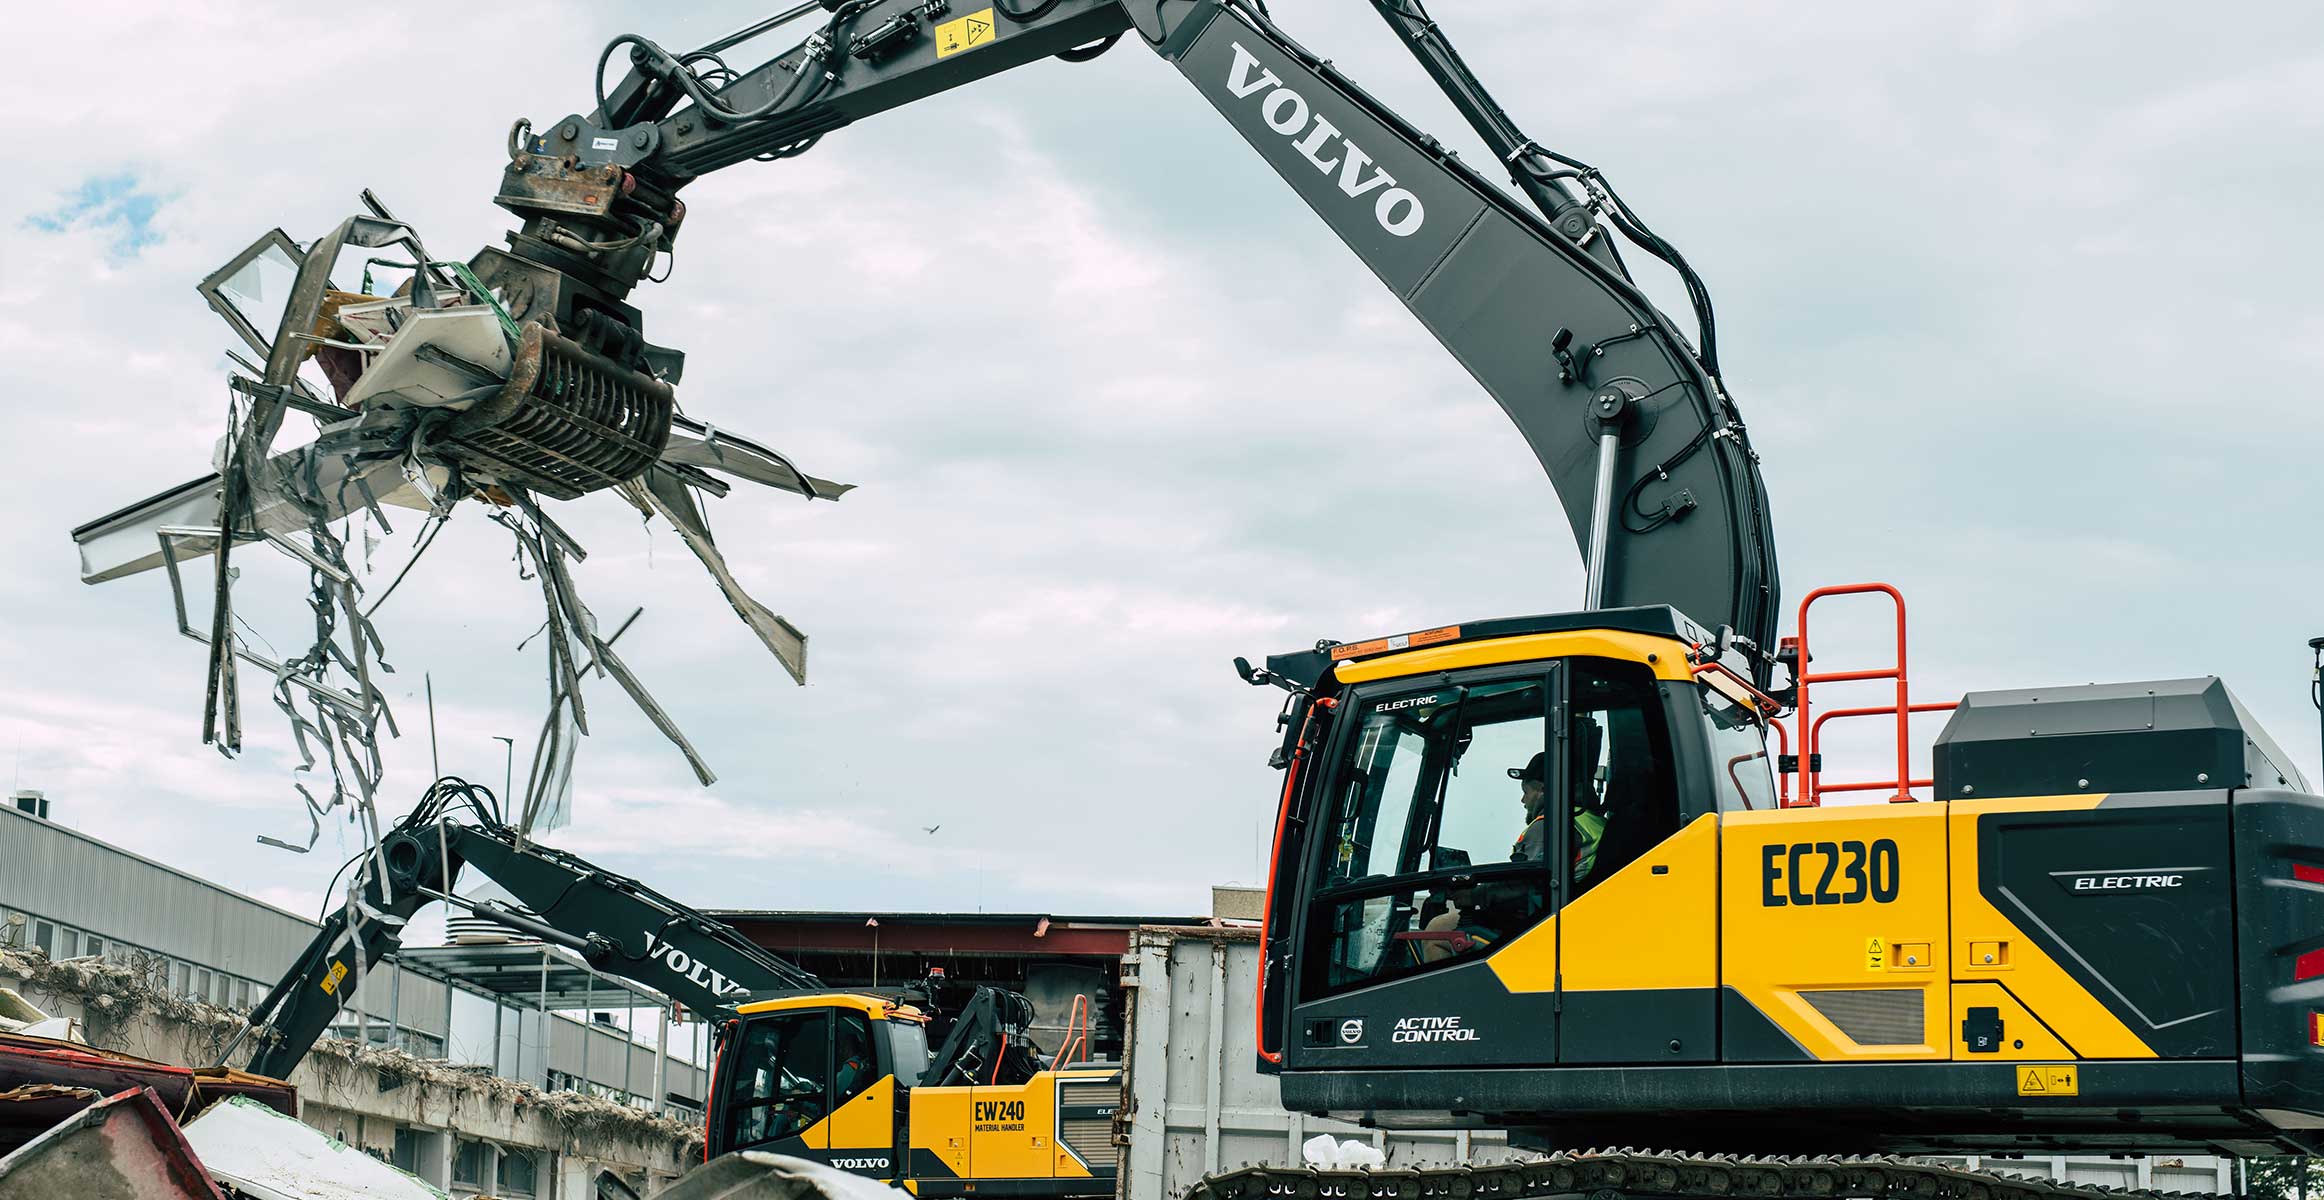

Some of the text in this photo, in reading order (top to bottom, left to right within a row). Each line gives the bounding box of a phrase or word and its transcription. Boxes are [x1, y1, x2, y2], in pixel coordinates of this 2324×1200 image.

[1226, 41, 1424, 237] VOLVO
[1376, 695, 1438, 713] ELECTRIC
[1762, 838, 1900, 907] EC230
[2074, 875, 2183, 890] ELECTRIC
[1394, 1016, 1461, 1030] ACTIVE
[1391, 1029, 1480, 1043] CONTROL
[975, 1100, 1025, 1121] EW240
[975, 1123, 1025, 1132] MATERIAL HANDLER
[830, 1158, 890, 1169] VOLVO
